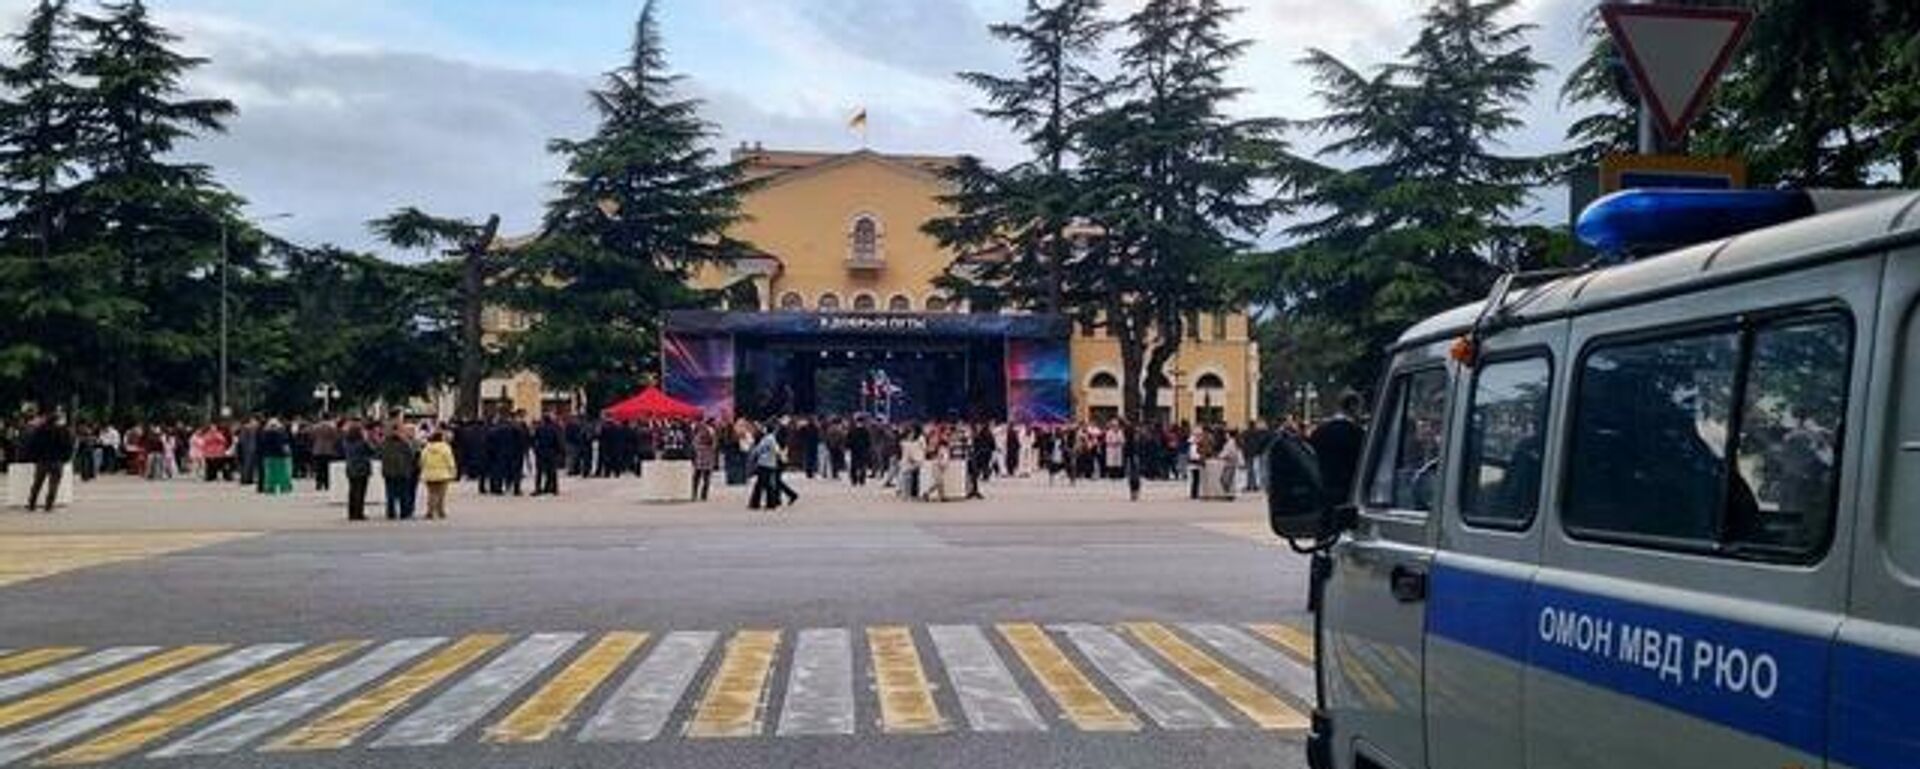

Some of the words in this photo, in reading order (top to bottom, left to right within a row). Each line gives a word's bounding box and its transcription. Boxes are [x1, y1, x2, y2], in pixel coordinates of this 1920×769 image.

[1539, 606, 1613, 658] ОМОН
[1619, 624, 1683, 684] МВД
[1693, 641, 1778, 699] РЮО
